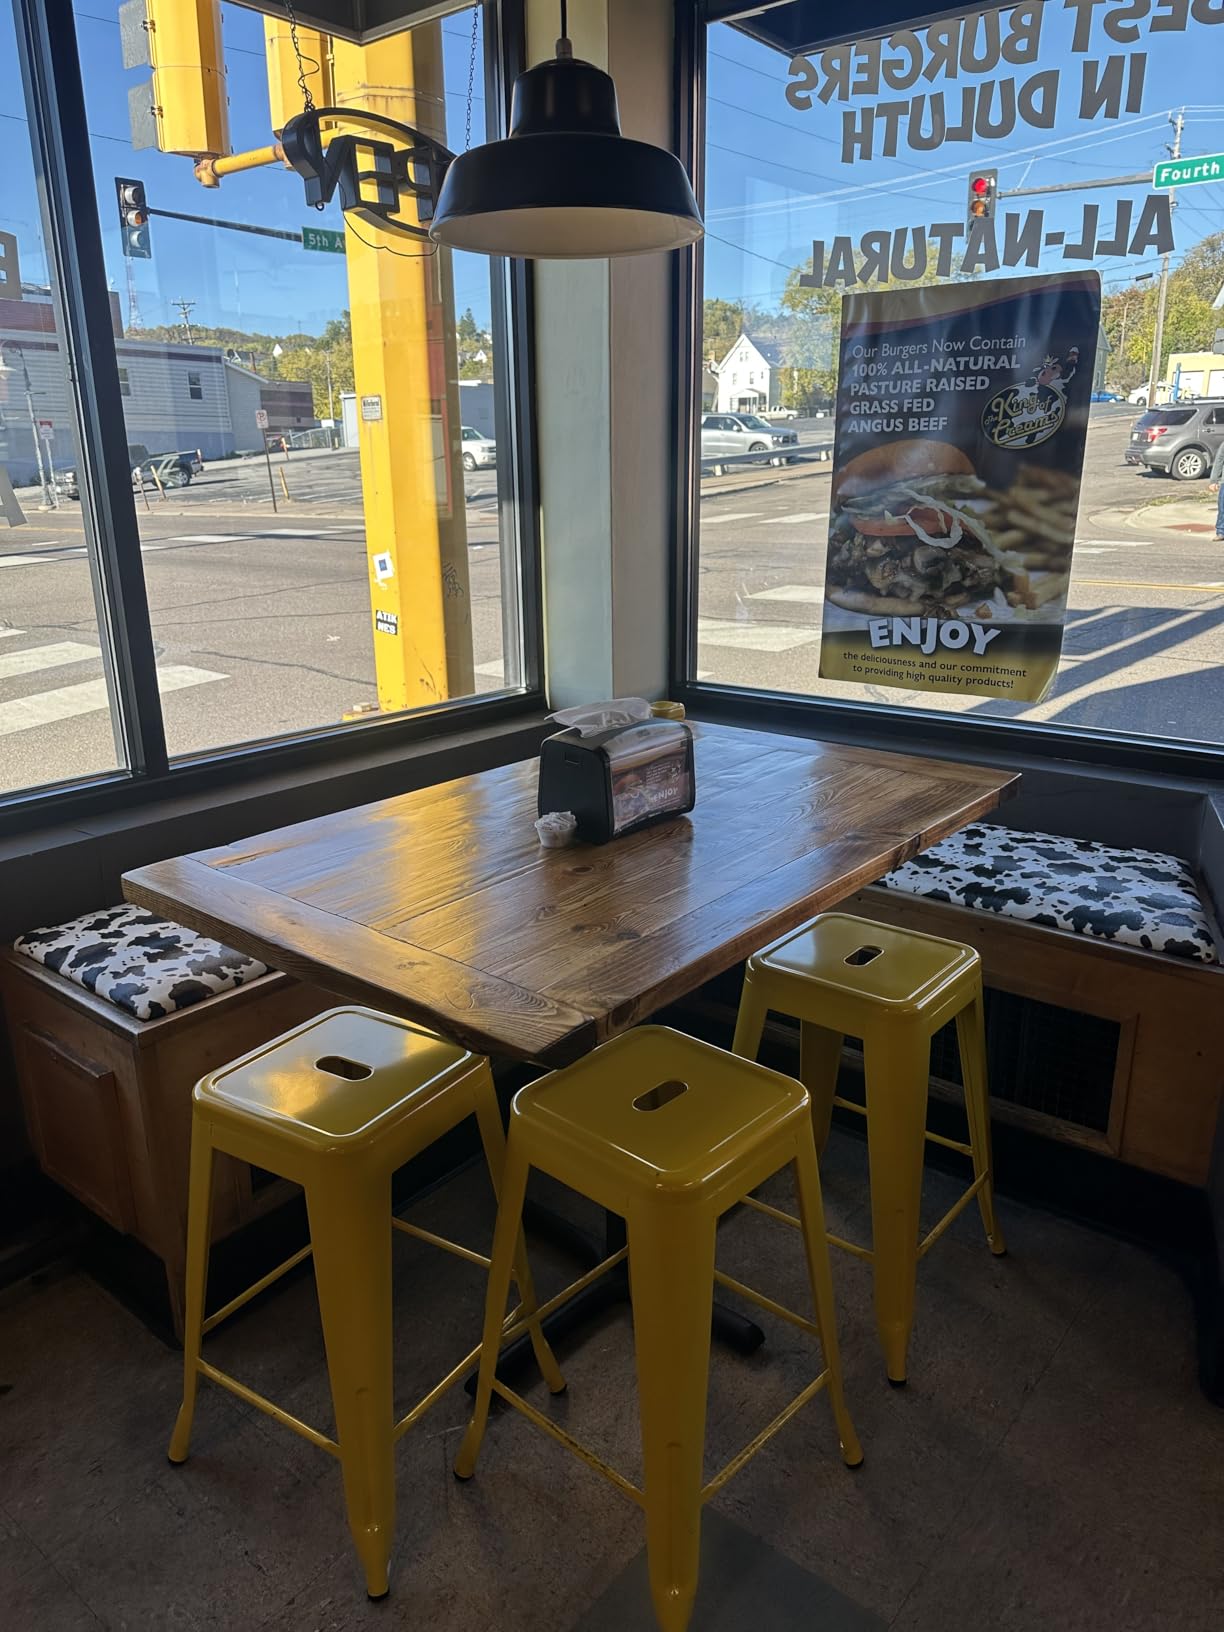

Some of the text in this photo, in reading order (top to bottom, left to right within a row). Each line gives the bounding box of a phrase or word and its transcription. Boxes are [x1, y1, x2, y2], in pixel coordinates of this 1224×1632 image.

[1160, 161, 1220, 182] Fourth
[309, 233, 345, 249] 5th A
[852, 335, 1026, 359] Our Burgers Now Contain
[852, 355, 1021, 377] 100% ALL-NATURAL
[850, 376, 990, 396] PASTURE RAISED
[850, 398, 935, 415] GRASS FED
[991, 392, 1038, 422] King
[1040, 395, 1053, 415] of
[848, 417, 948, 433] ANGUS BEEF
[992, 412, 1059, 445] Creams
[869, 616, 1001, 656] ENJOY
[843, 652, 1027, 678] the deliciousness and our commitment
[864, 666, 904, 680] providing
[906, 670, 926, 682] high
[928, 673, 962, 686] quality
[965, 677, 1014, 689] products!
